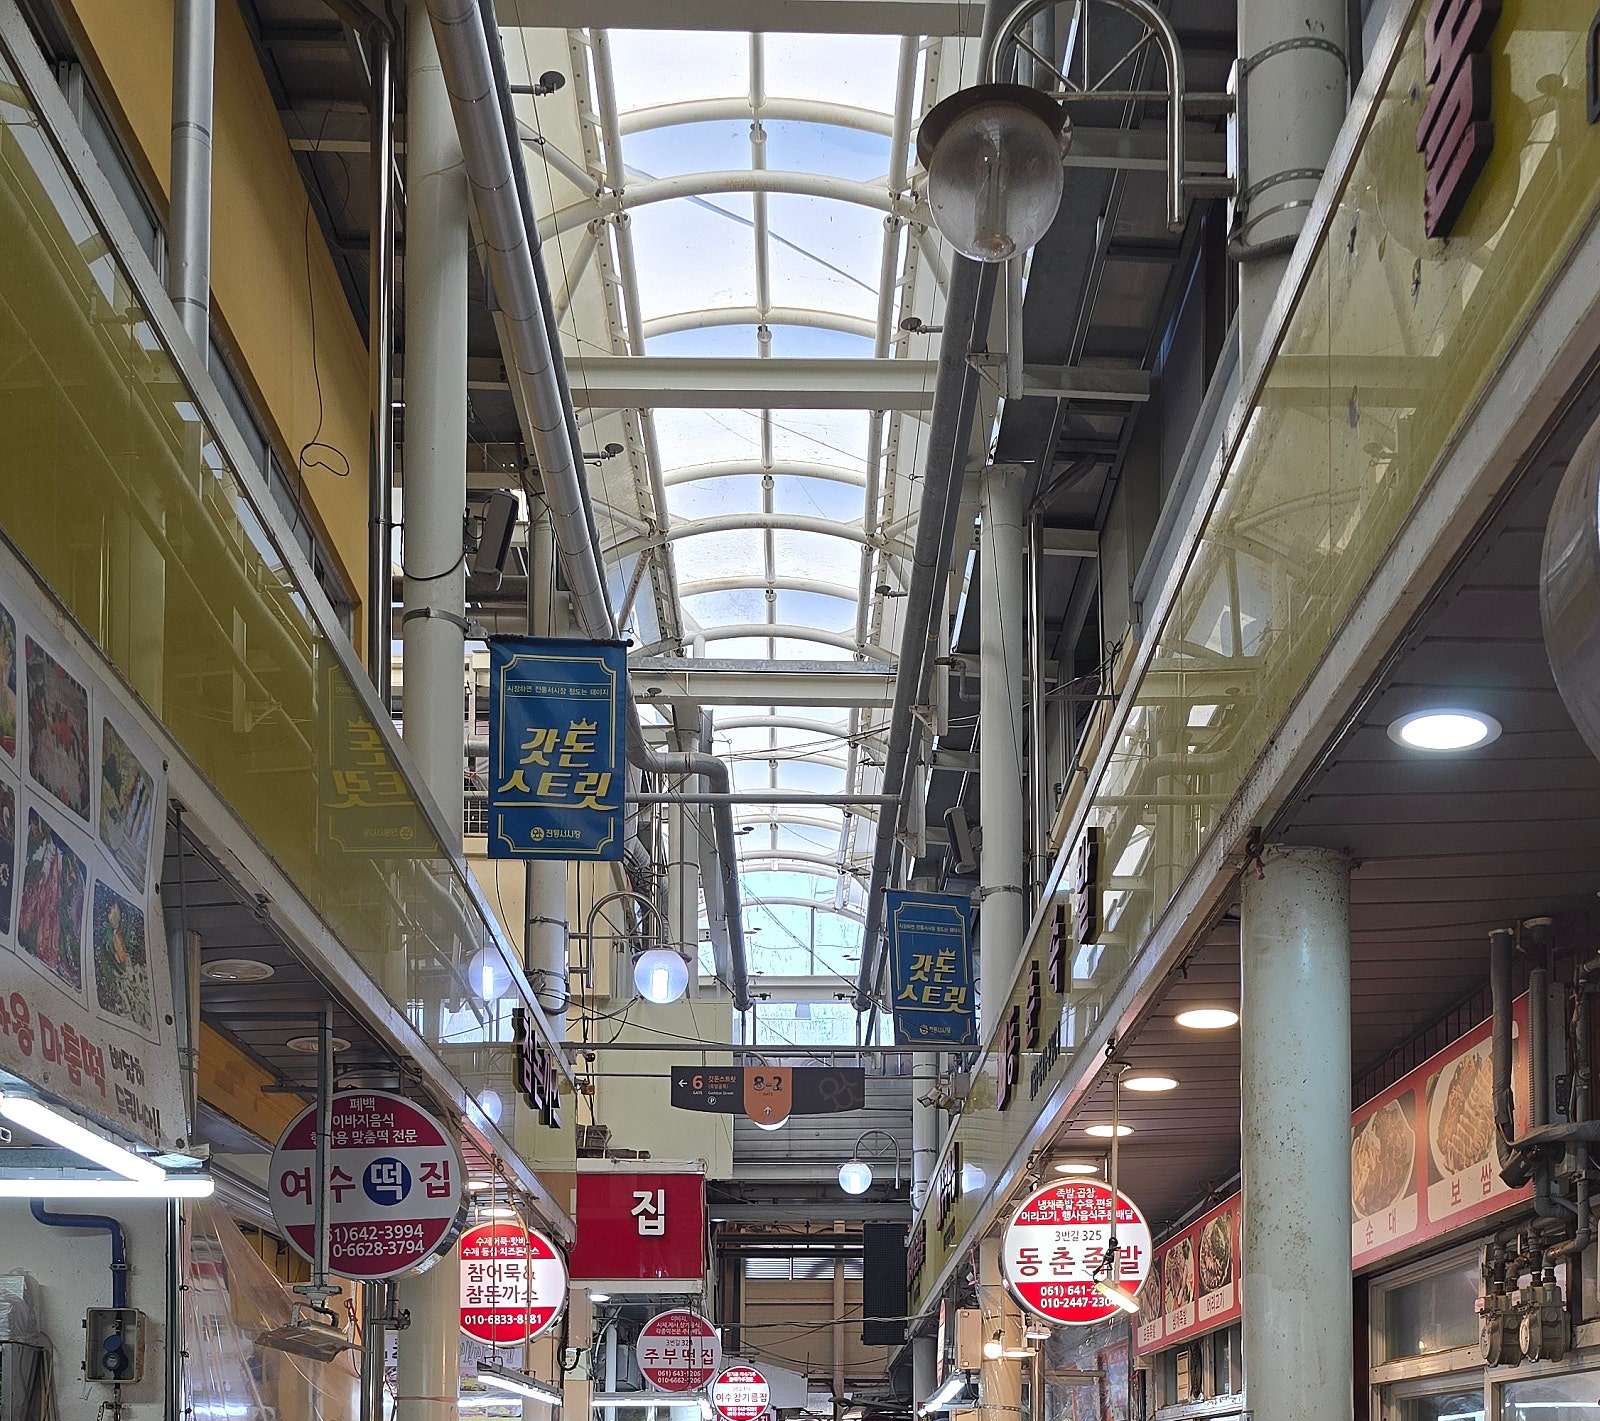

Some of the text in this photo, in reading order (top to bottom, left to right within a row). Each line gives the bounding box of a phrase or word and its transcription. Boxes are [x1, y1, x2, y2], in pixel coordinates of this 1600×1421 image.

[519, 728, 597, 768] 갓돈
[492, 769, 620, 811] 스트릿
[909, 954, 957, 983] 갓돈
[895, 984, 973, 1014] 스트릿
[692, 1075, 704, 1090] 6
[753, 1075, 783, 1091] 8-2
[349, 1097, 376, 1111] 폐백
[332, 1113, 395, 1128] 이바지음식
[351, 1130, 389, 1145] 맞춤떡
[392, 1129, 418, 1143] 전문
[1450, 1161, 1493, 1207] 보쌈
[630, 1189, 665, 1236] 집
[314, 1223, 425, 1243] 61)642-3994
[1365, 1205, 1397, 1246] 순대
[1054, 1230, 1102, 1242] 3번길 325
[333, 1239, 425, 1258] 0-6628-3794
[1015, 1245, 1143, 1277] 동춘족발
[466, 1285, 539, 1304] 참돈까스
[1040, 1285, 1064, 1297] 061)
[643, 1348, 714, 1366] 주부떡집
